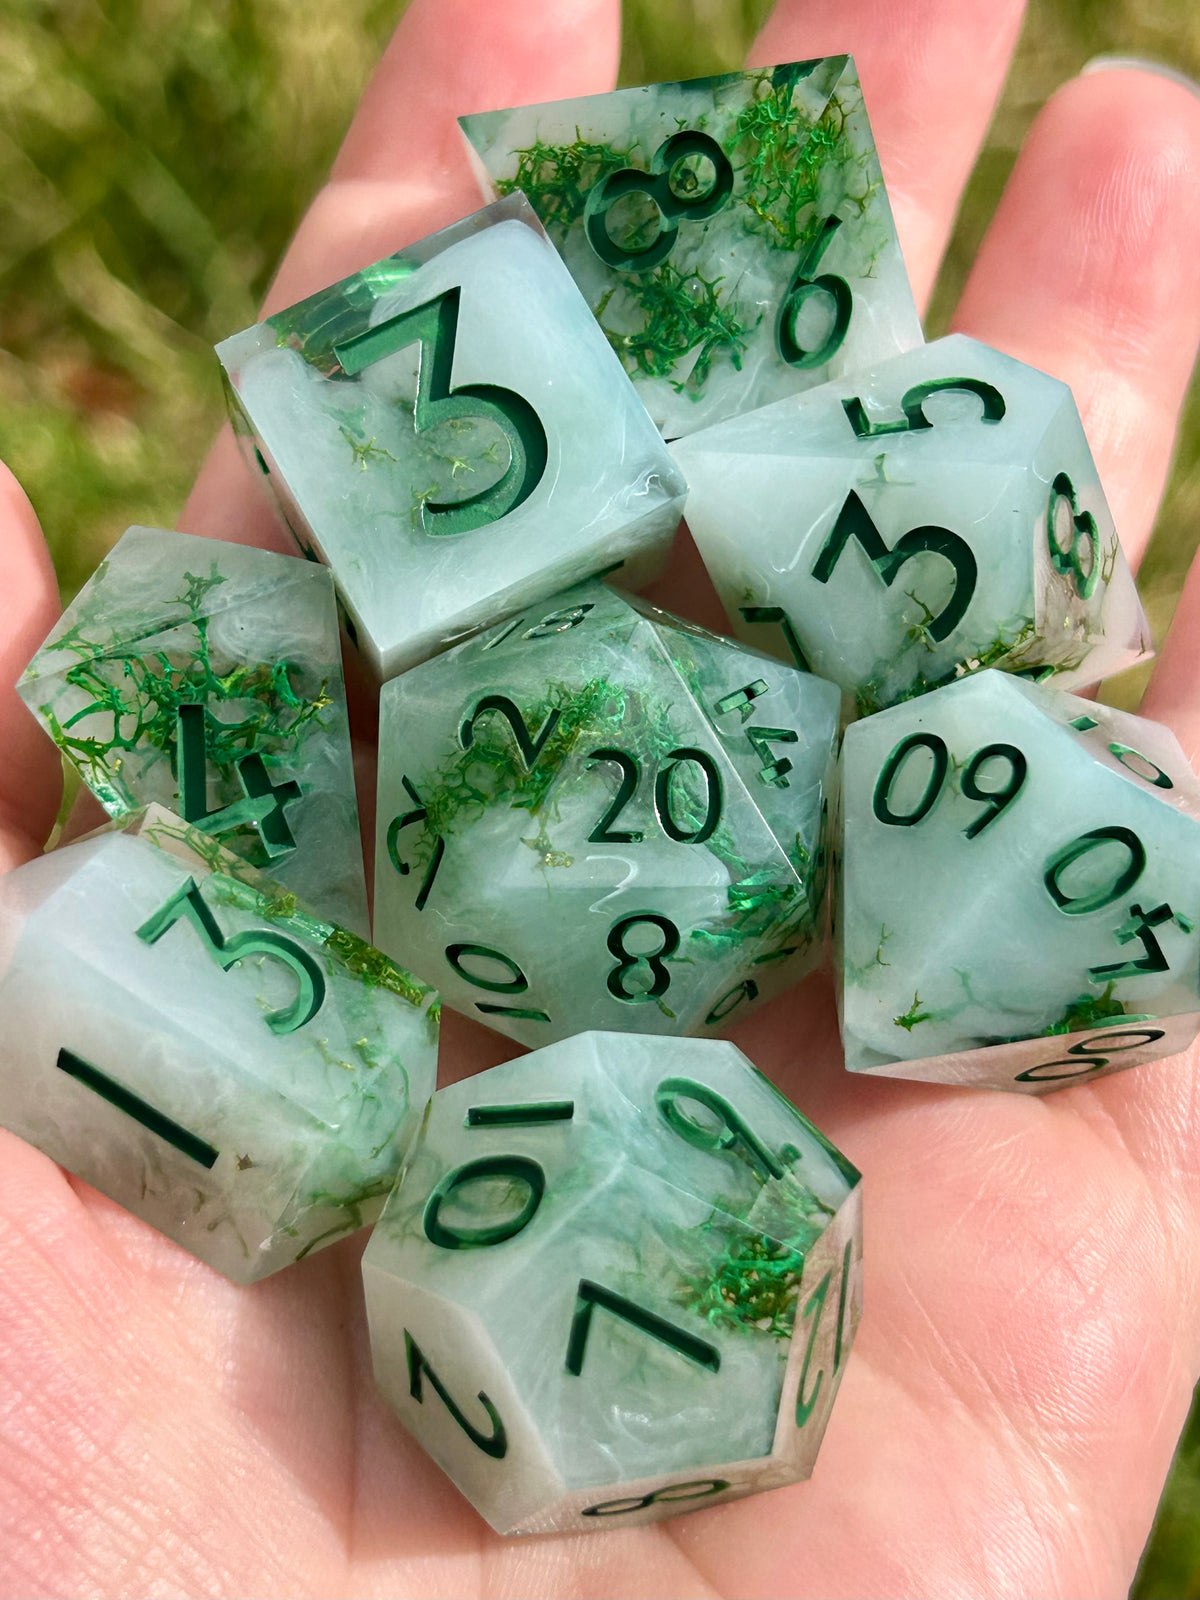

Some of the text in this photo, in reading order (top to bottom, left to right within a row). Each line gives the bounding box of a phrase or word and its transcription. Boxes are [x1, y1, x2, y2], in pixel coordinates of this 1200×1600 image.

[584, 130, 734, 273] 8
[333, 285, 548, 537] 3
[841, 376, 1006, 438] 5
[811, 488, 978, 643] 3
[1047, 472, 1099, 600] 8
[176, 704, 303, 858] 4
[458, 694, 561, 774] 2
[585, 747, 725, 844] 20
[134, 876, 325, 1035] 3
[606, 911, 680, 1004] 8
[56, 1047, 219, 1169] 1
[565, 1278, 721, 1376] 7
[403, 1327, 507, 1459] 2
